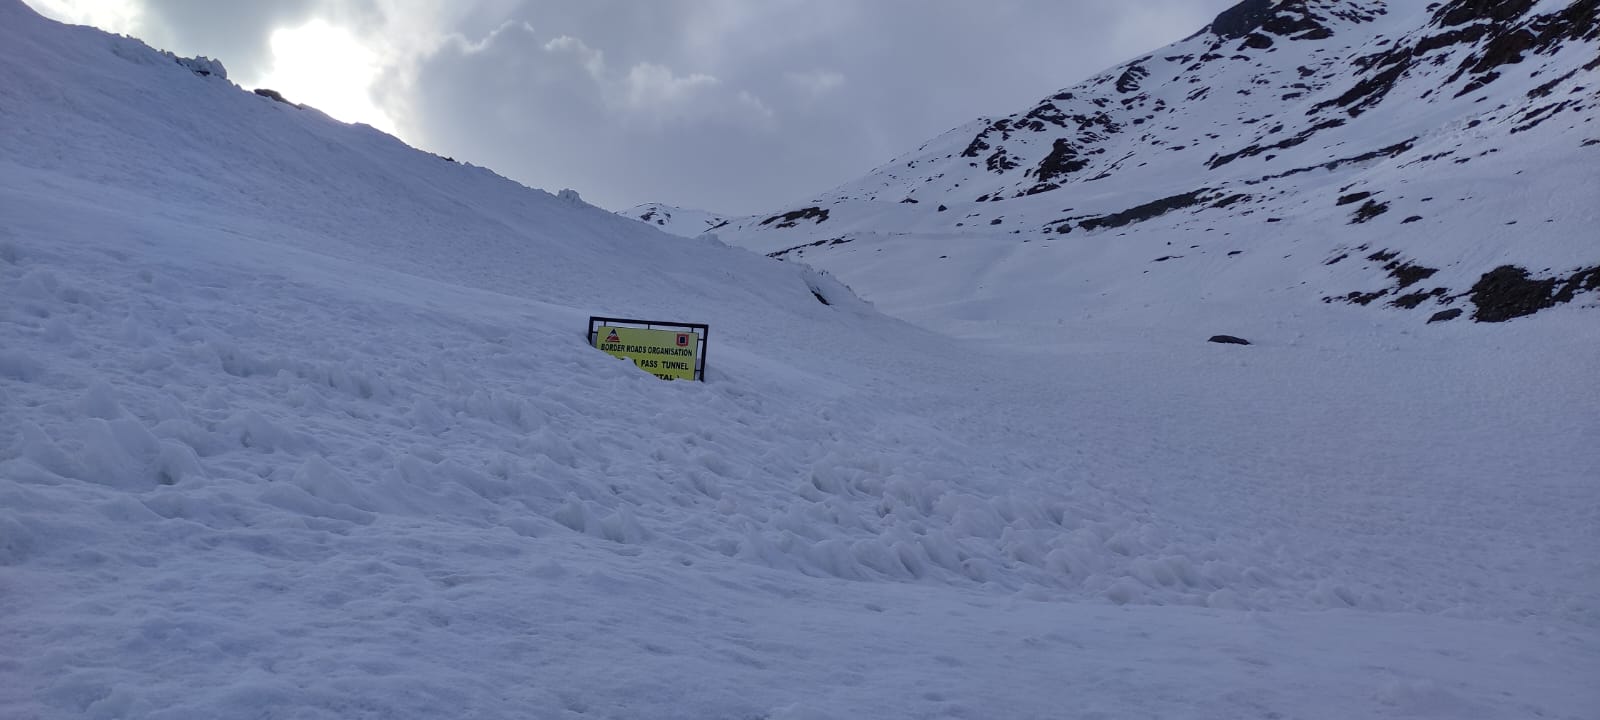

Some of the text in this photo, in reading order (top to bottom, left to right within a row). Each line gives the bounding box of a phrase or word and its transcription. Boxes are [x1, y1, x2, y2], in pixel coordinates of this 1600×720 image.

[600, 343, 693, 357] BORDER ROADS ORGANISATION
[640, 359, 658, 368] PASS
[661, 360, 689, 370] TUNNEL
